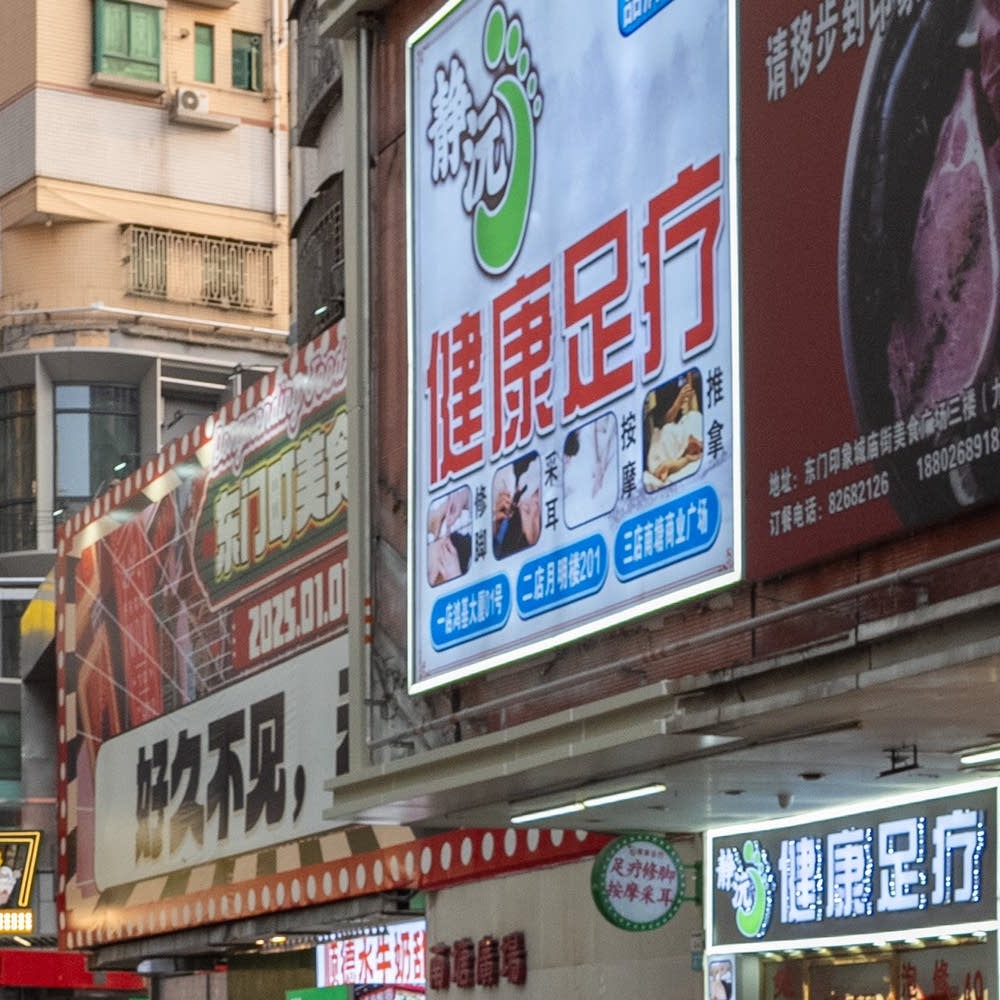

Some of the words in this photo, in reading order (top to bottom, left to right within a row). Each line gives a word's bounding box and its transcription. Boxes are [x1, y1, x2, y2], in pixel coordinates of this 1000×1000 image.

[427, 154, 721, 486] 健康足疗
[621, 414, 636, 499] 按摩
[707, 369, 724, 459] 推拿
[545, 452, 559, 530] 采耳
[779, 808, 987, 923] 健康足疗
